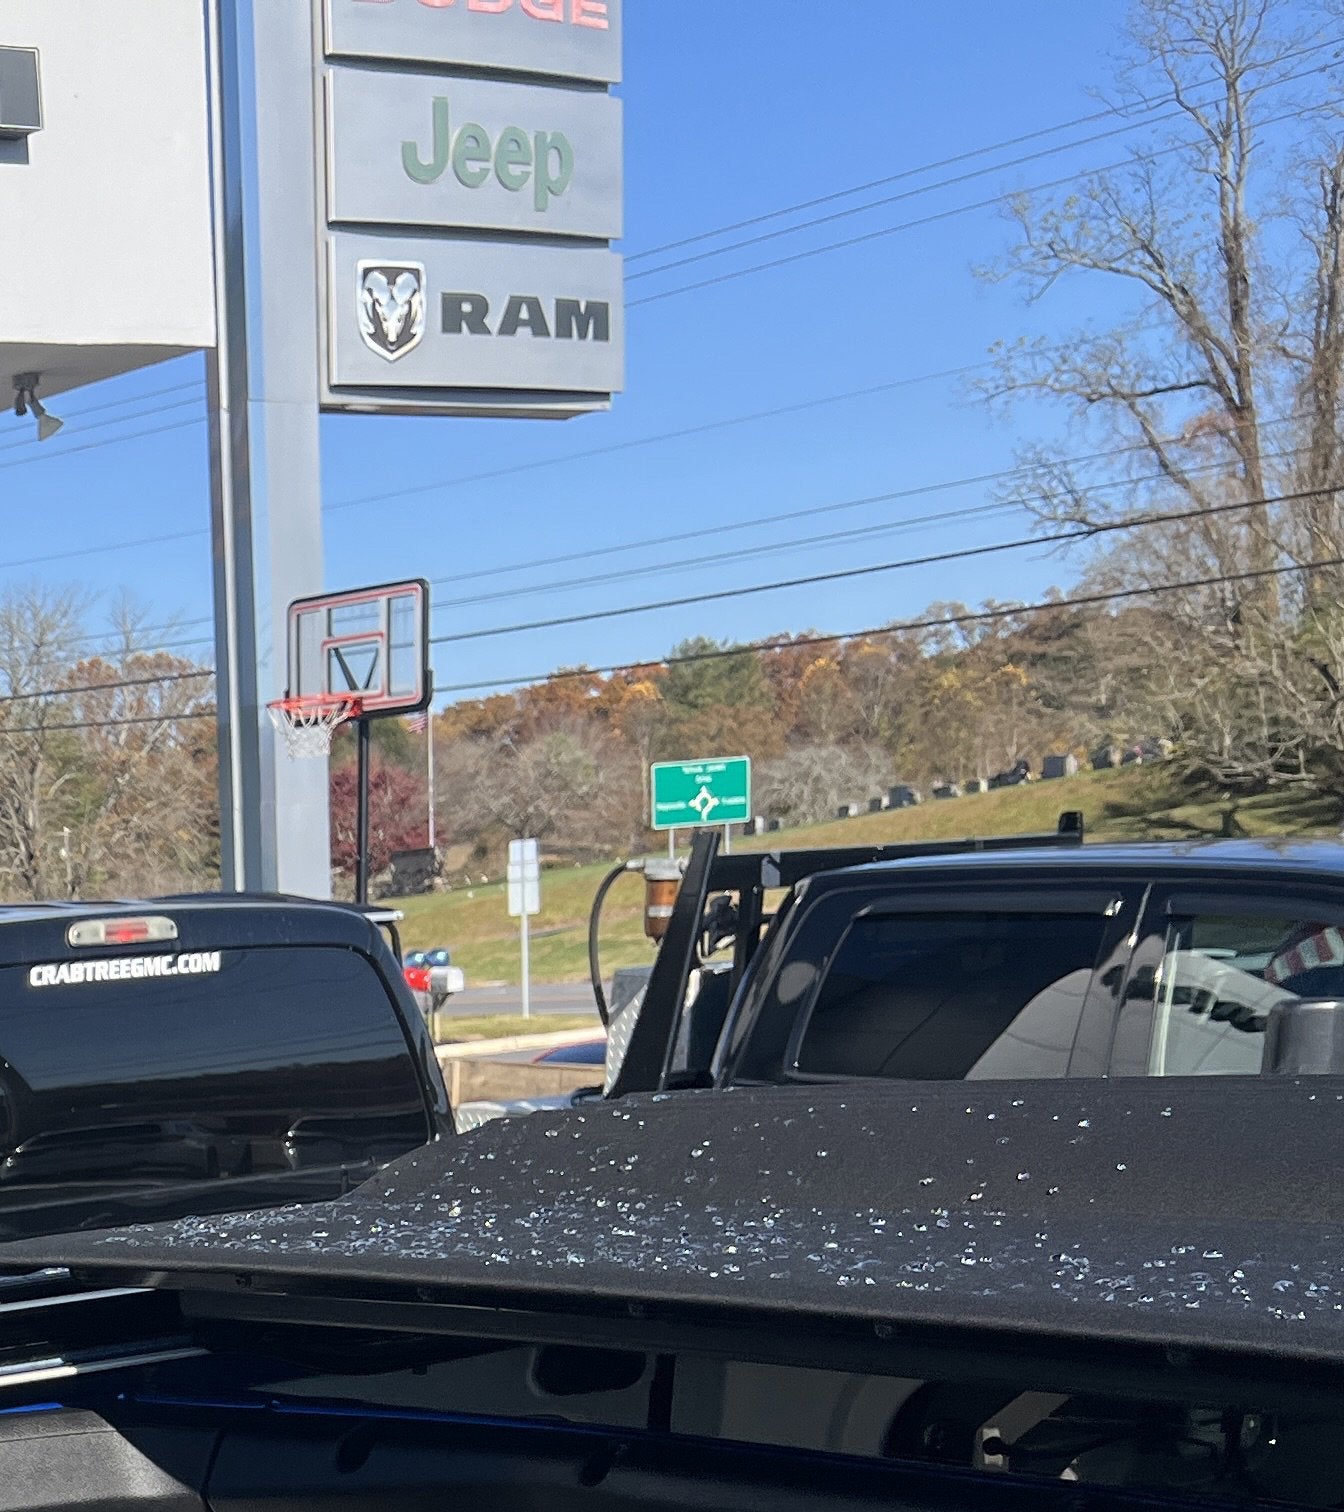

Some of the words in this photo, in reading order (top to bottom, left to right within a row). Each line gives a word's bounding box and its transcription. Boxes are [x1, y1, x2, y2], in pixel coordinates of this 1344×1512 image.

[401, 96, 575, 212] Jeep
[441, 291, 610, 342] RAM
[29, 951, 221, 987] CRABTREEGMC.COM
